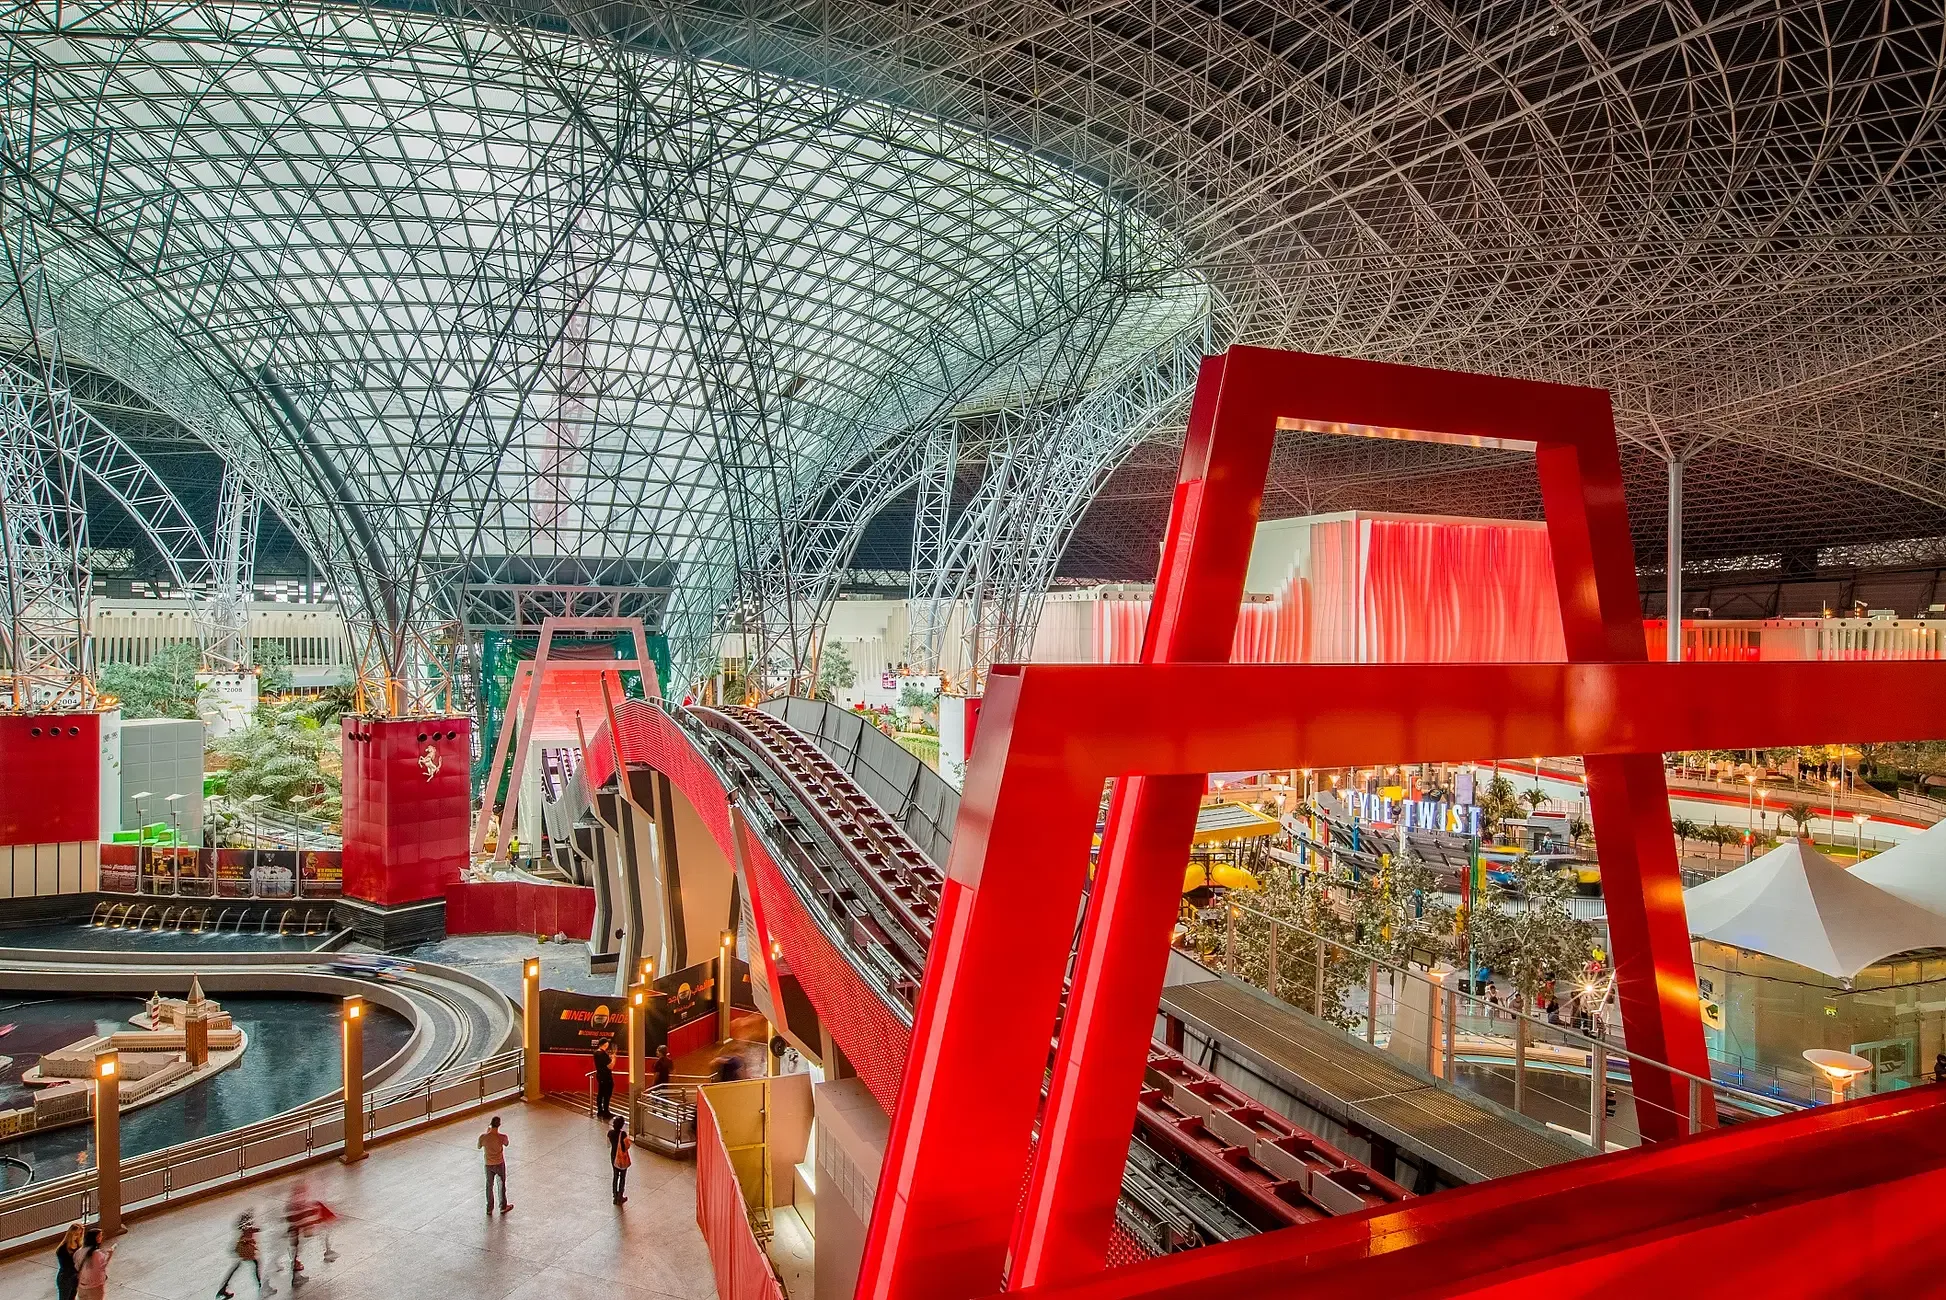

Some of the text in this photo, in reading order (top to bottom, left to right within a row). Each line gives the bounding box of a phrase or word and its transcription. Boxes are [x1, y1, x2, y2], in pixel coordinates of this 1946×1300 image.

[1346, 789, 1482, 836] TYRE TWIST
[570, 1010, 593, 1021] NEW
